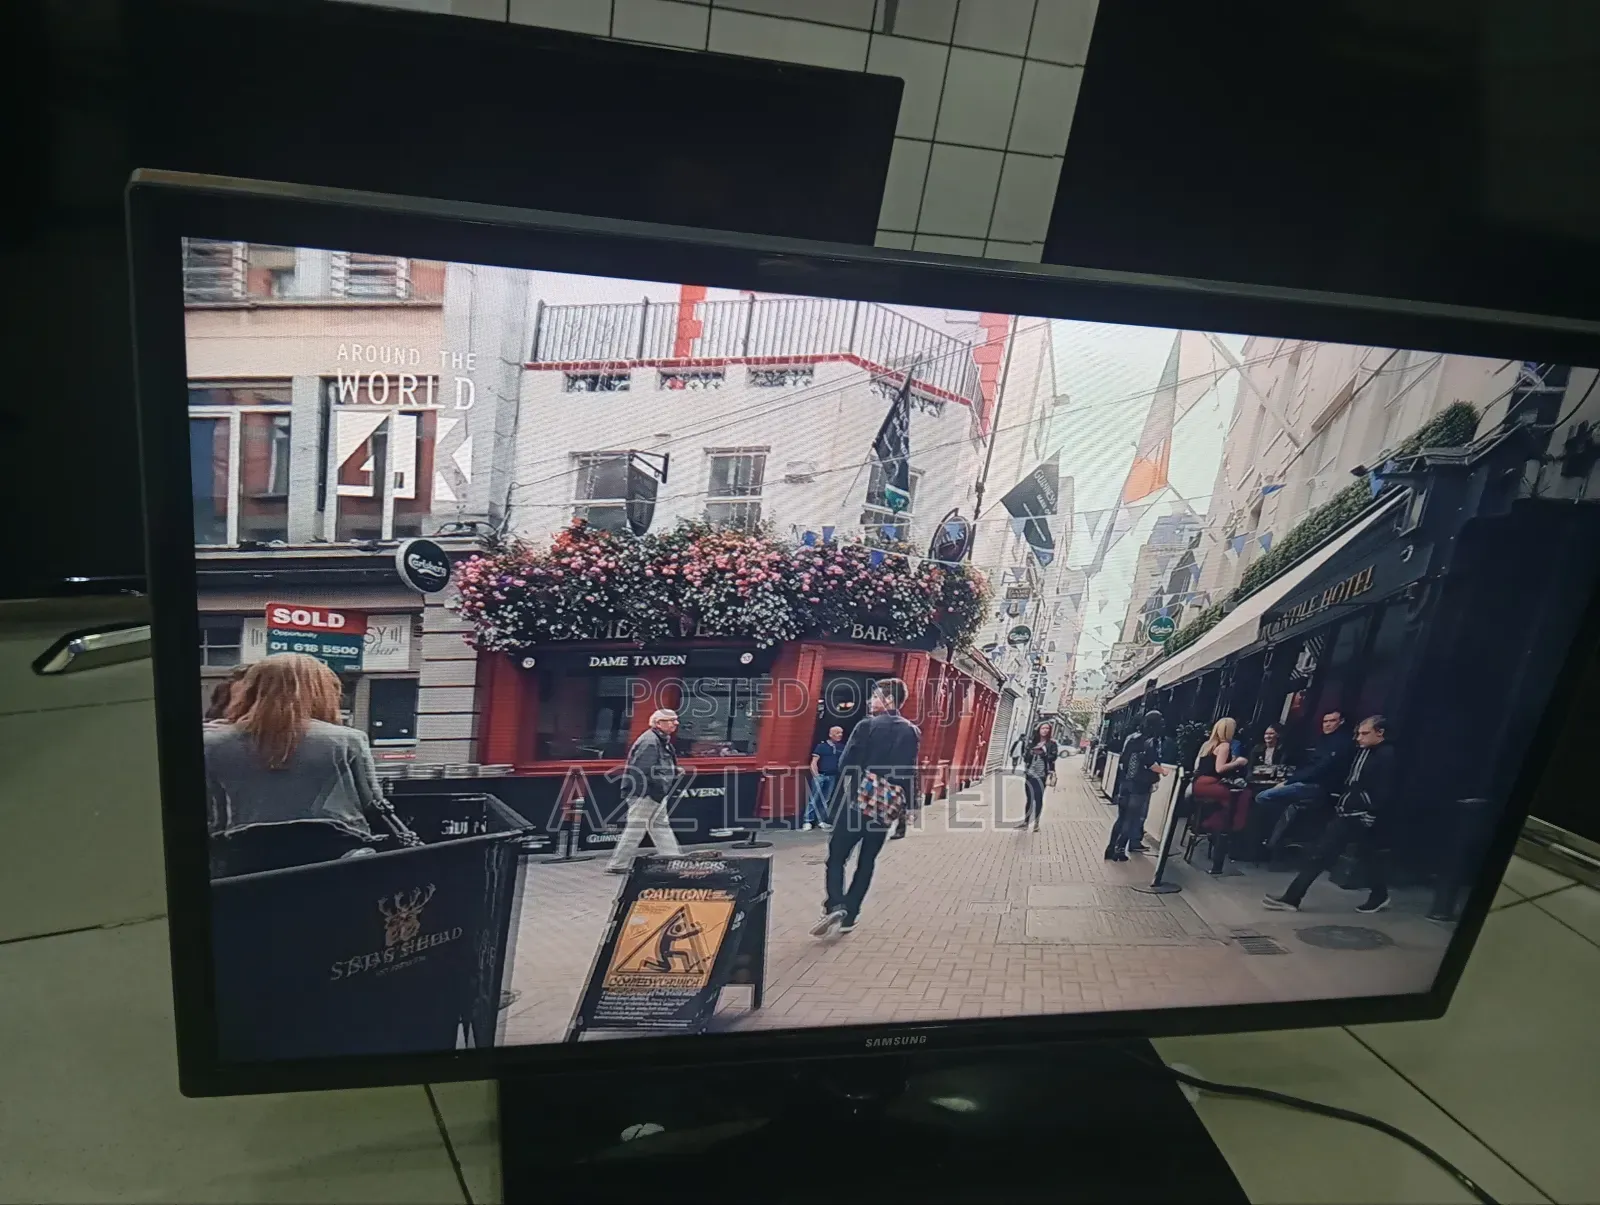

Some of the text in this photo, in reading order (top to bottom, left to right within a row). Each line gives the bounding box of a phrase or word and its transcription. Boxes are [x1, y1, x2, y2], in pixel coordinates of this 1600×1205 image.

[337, 343, 477, 371] AROUND THE
[336, 368, 475, 411] WORLD
[336, 410, 473, 501] 4K
[1319, 563, 1376, 609] HOTEL
[272, 607, 346, 628] SOLD
[851, 623, 889, 641] BAR
[270, 641, 288, 651] 01
[322, 645, 359, 655] 5500
[589, 655, 687, 667] DAME TAVERN
[586, 834, 623, 843] GUINNE
[865, 1035, 927, 1047] SAMSUNG
